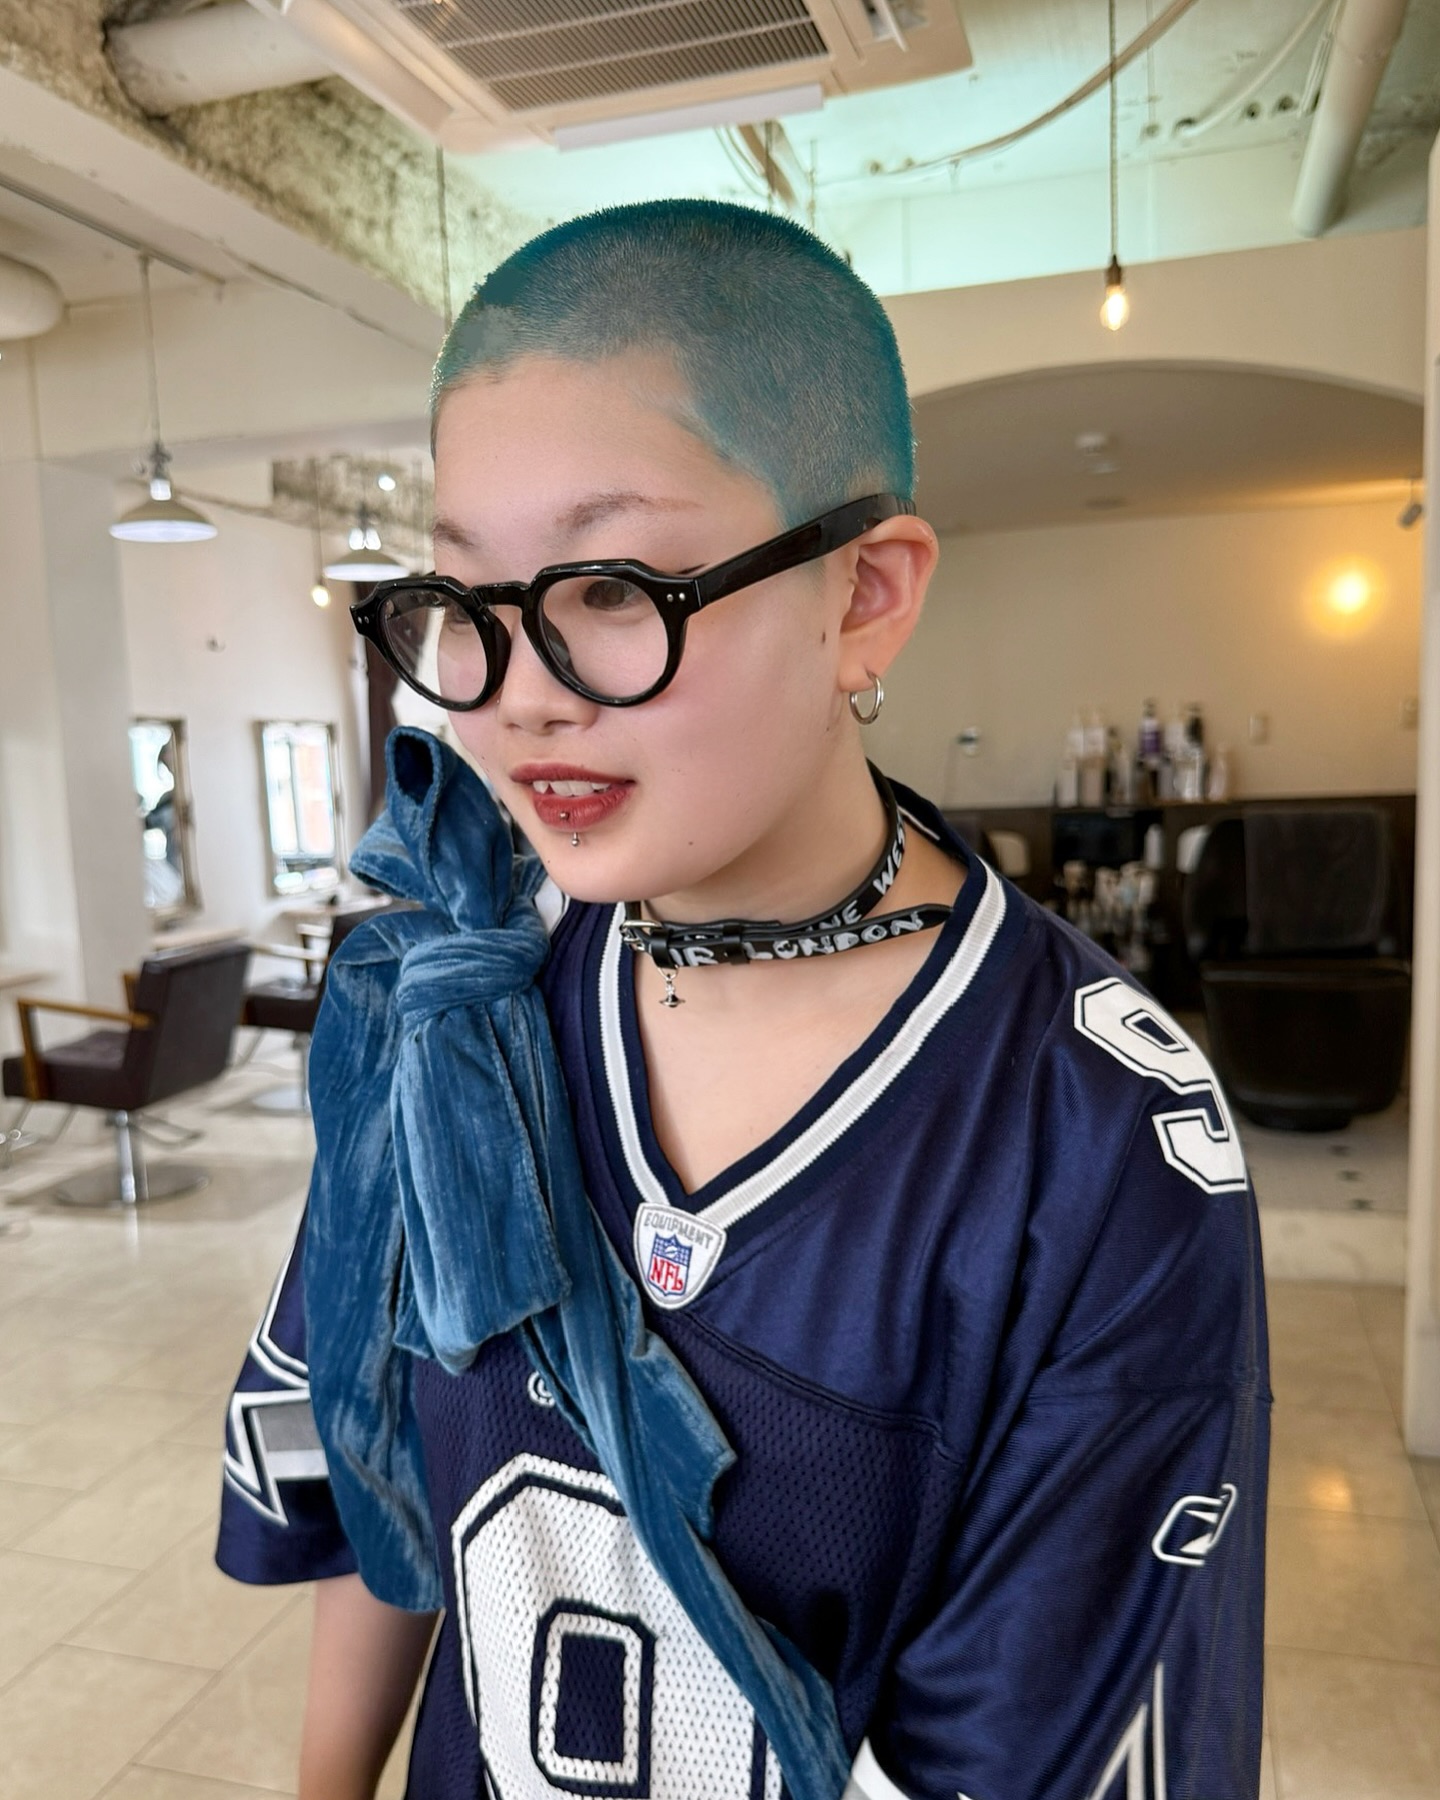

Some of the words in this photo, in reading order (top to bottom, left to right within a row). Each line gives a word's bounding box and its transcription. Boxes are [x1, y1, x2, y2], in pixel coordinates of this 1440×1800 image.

[742, 911, 924, 960] LONDON
[1074, 977, 1248, 1194] 9
[644, 1212, 713, 1249] EQUIPMENT
[650, 1256, 684, 1292] NFL
